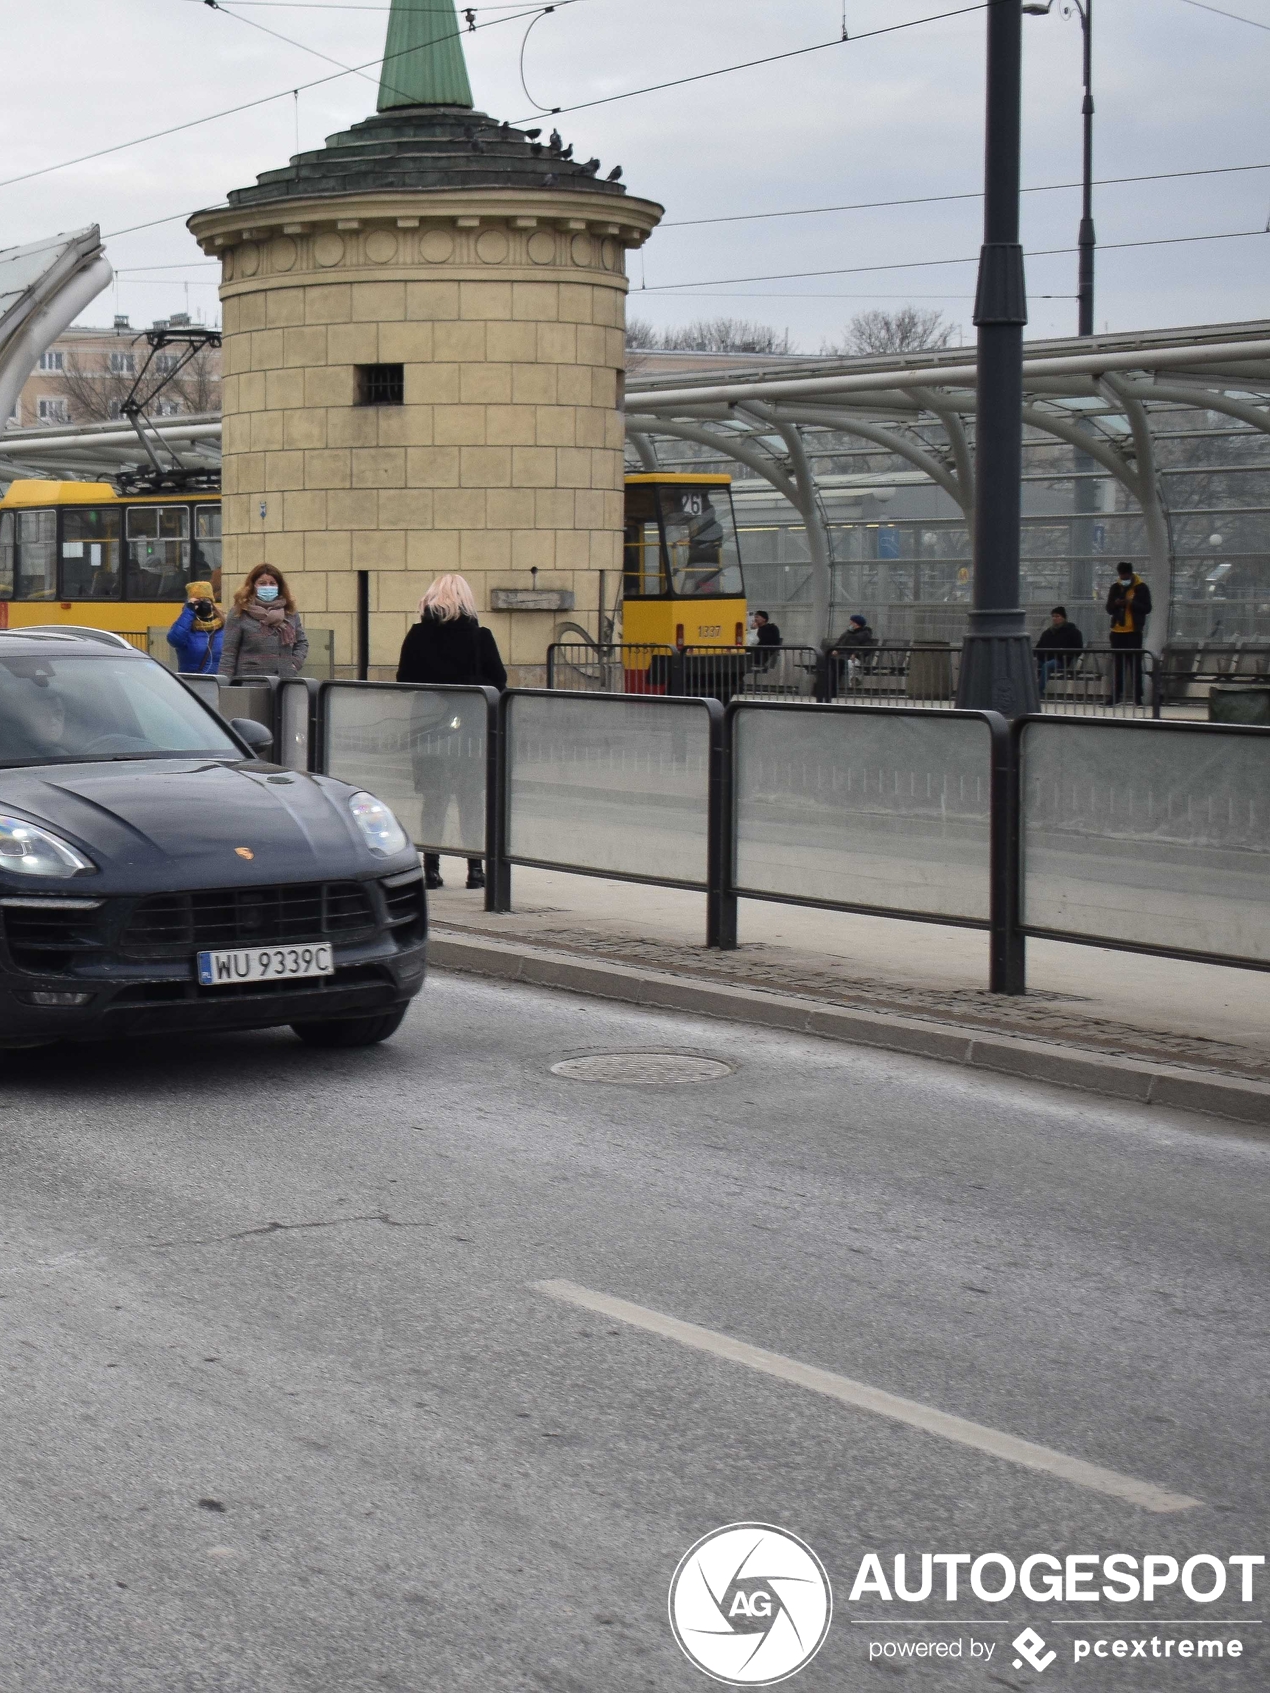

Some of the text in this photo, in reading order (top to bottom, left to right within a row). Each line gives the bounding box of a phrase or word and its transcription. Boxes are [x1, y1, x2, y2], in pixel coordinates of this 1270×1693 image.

[698, 625, 722, 638] 1337
[215, 947, 330, 980] WU 9339C
